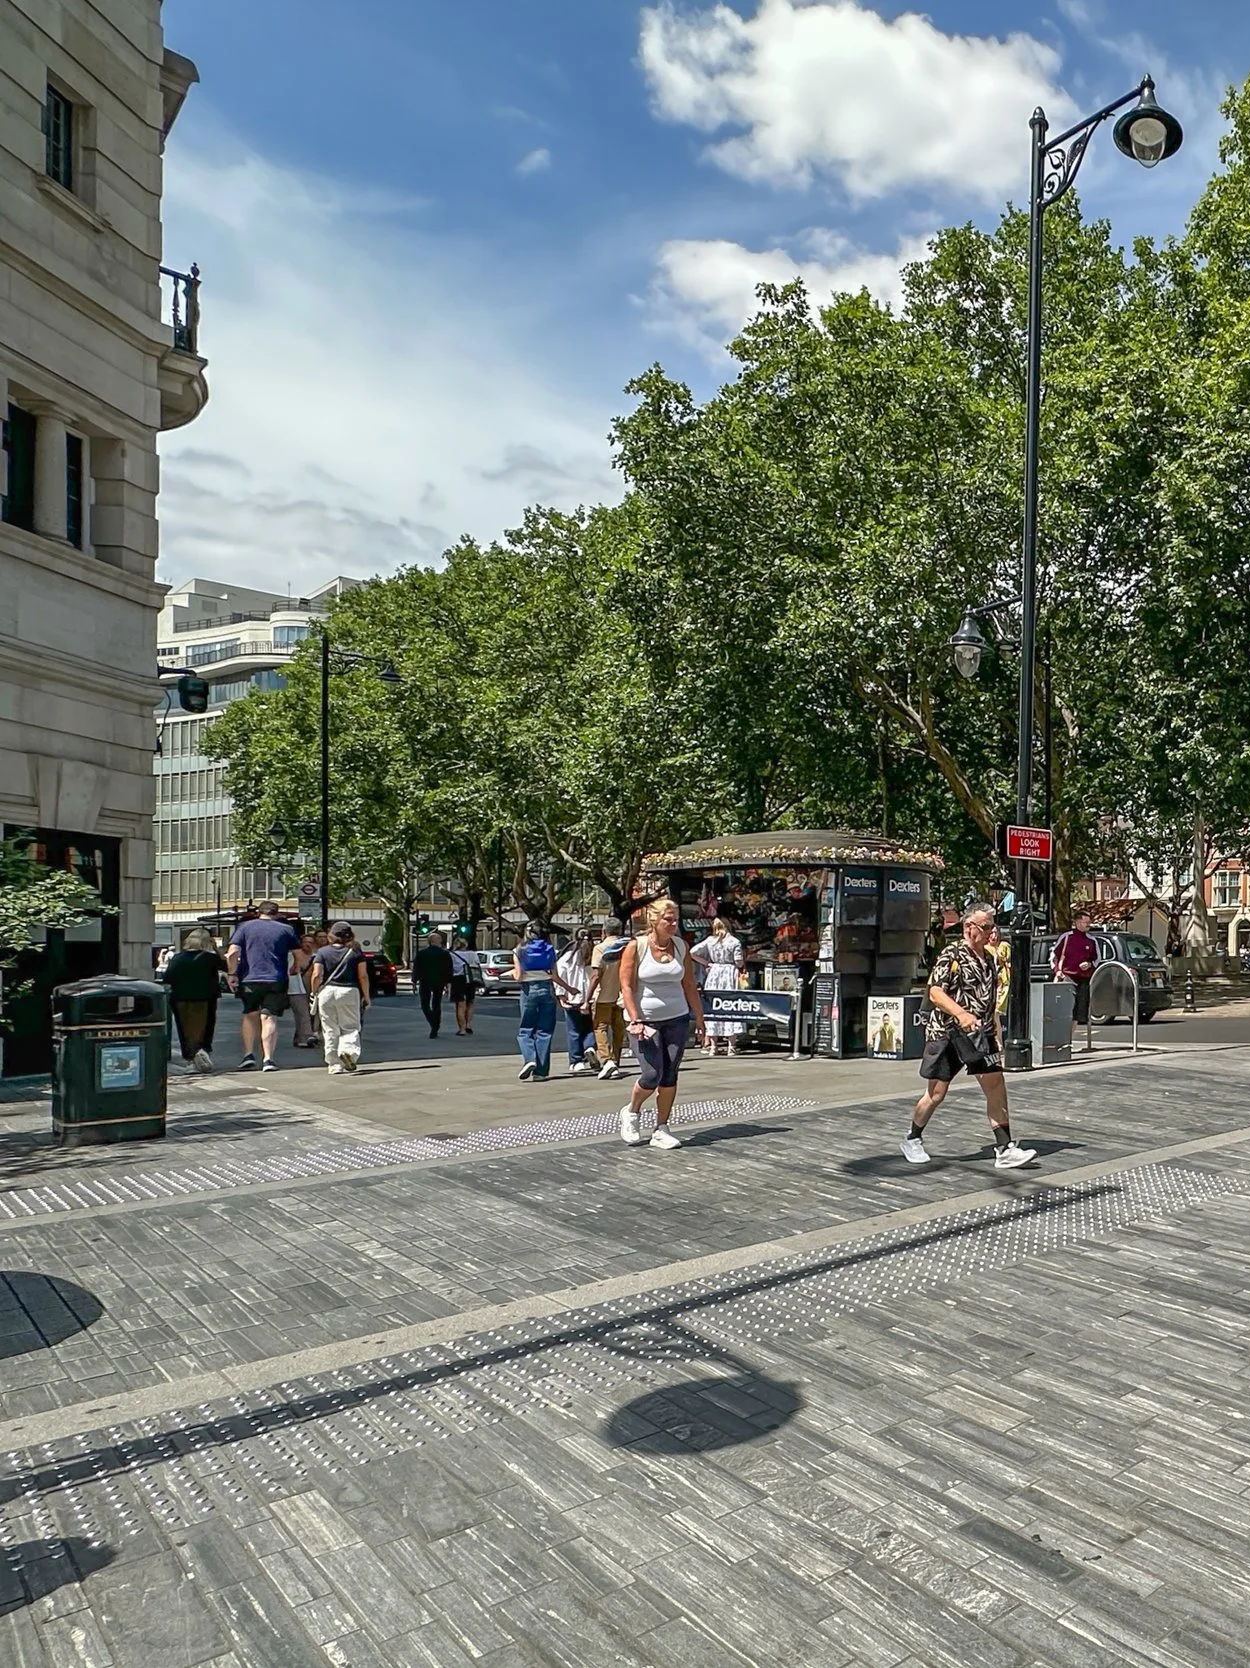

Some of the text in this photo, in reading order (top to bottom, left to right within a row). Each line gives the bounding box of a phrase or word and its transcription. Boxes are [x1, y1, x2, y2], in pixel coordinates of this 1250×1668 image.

[1010, 829, 1050, 840] PEDESTRIANS
[1020, 838, 1040, 847] LOOK
[1020, 848, 1041, 857] RIGHT
[844, 876, 877, 888] Dexters
[889, 879, 920, 893] Dexters
[712, 997, 760, 1012] Dexters
[872, 1000, 899, 1010] Dexters
